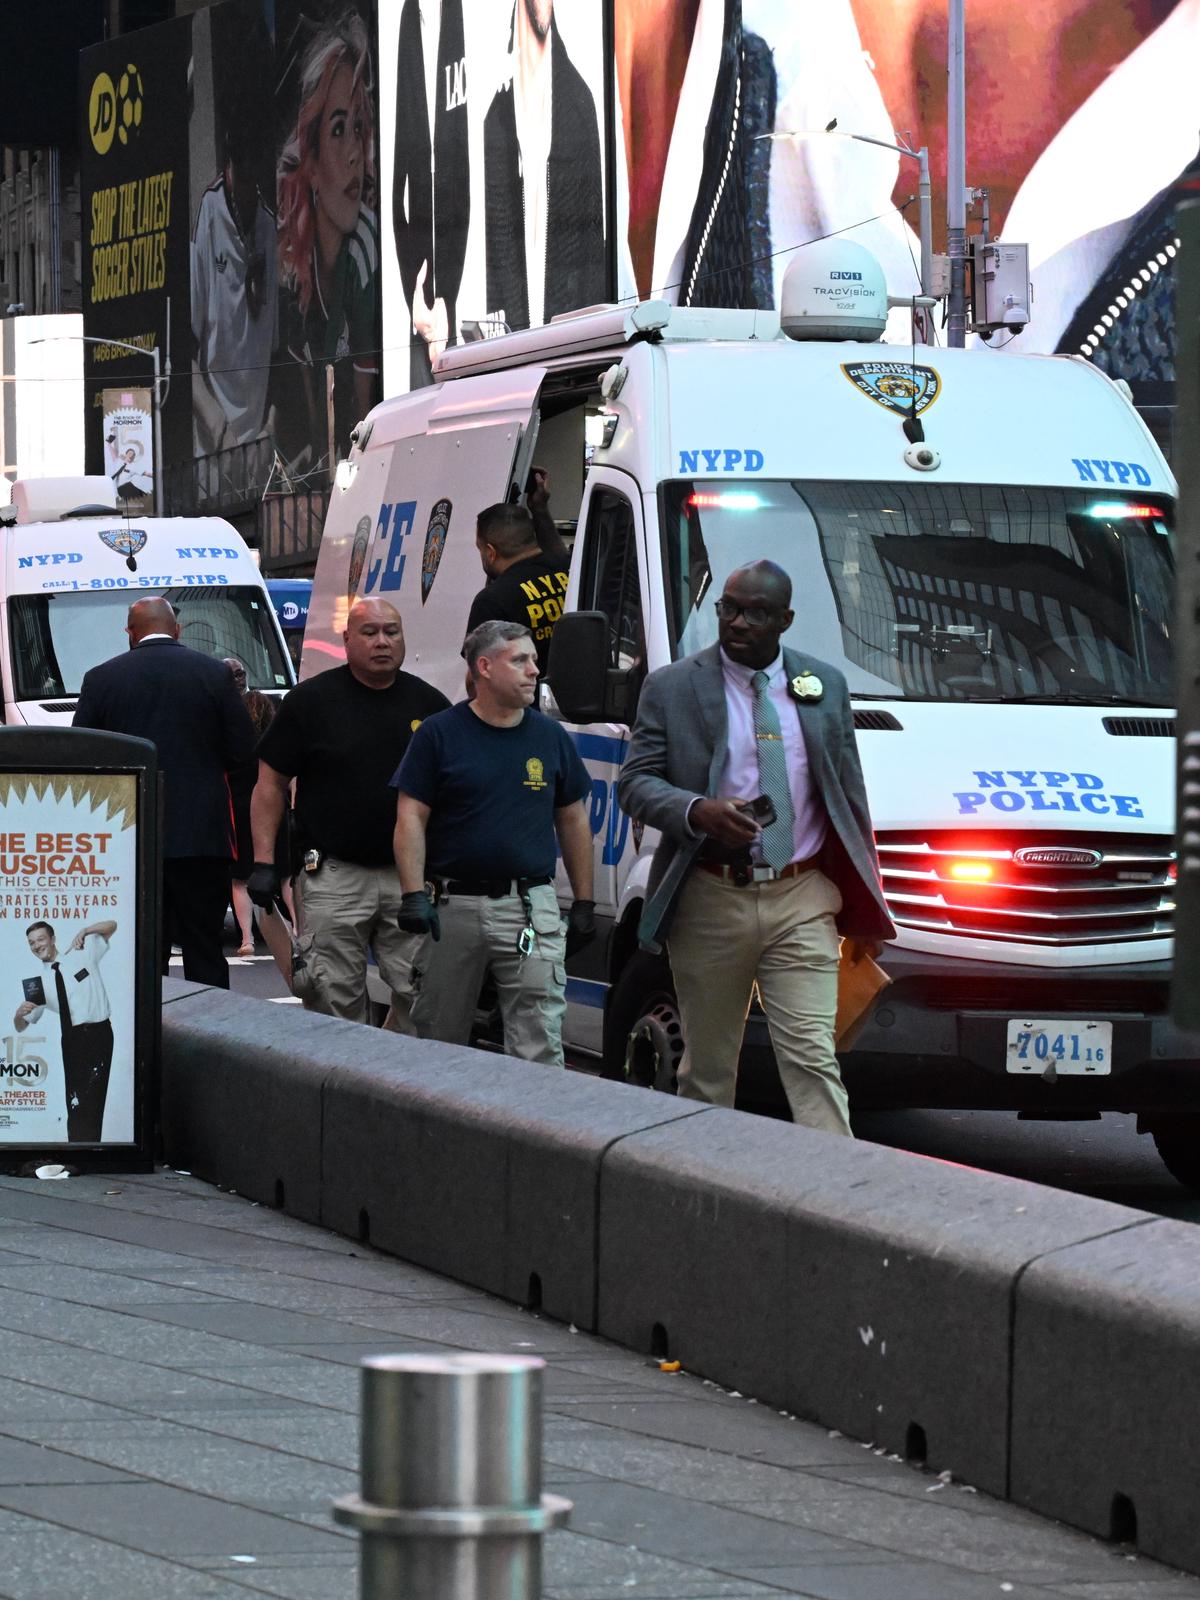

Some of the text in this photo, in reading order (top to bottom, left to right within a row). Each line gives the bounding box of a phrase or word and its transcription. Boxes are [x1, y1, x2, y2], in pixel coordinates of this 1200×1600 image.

[93, 92, 113, 137] JD
[91, 170, 174, 247] SHOP THE LATEST
[91, 231, 167, 304] SOCCER STYLES
[830, 271, 862, 281] RV1
[94, 332, 157, 363] 1466 BROADWAY
[849, 367, 933, 379] DEPARTMENT
[856, 381, 879, 396] CITY
[878, 397, 895, 407] OF
[915, 396, 930, 411] NEW
[679, 449, 765, 473] NYPD
[1071, 457, 1152, 487] NYPD
[18, 552, 84, 569] NYPD
[175, 547, 240, 560] NYPD
[71, 574, 229, 591] 1-800-577-TIPS
[520, 571, 569, 601] N.Y.P
[283, 606, 296, 616] MTA
[972, 770, 1105, 790] NYPD
[952, 789, 1145, 819] POLICE
[35, 832, 113, 854] BEST
[1025, 852, 1093, 863] FREIGHTLINER
[55, 894, 69, 906] 15
[74, 894, 119, 906] YEARS
[14, 907, 90, 919] BROADWAY
[1016, 1032, 1105, 1062] 7041 16
[17, 1098, 47, 1106] STYLE.
